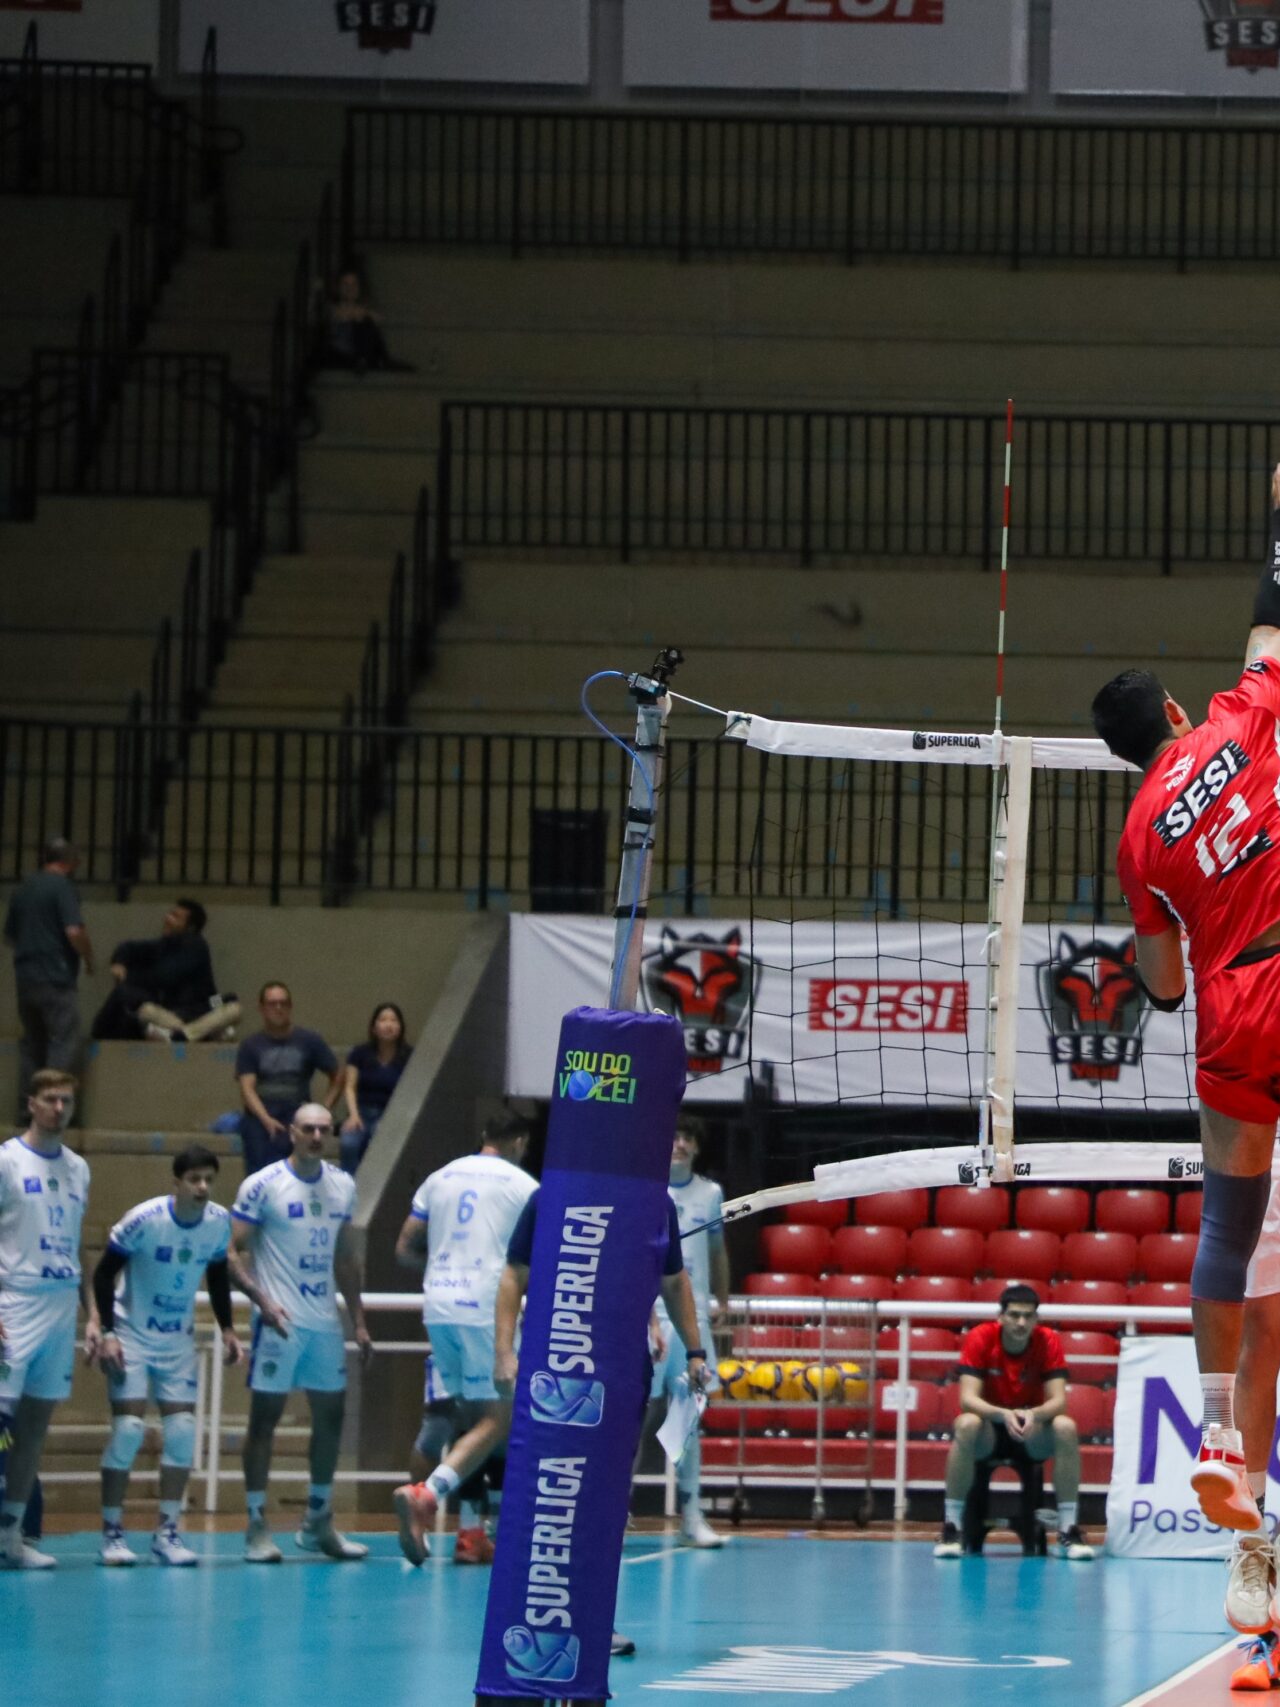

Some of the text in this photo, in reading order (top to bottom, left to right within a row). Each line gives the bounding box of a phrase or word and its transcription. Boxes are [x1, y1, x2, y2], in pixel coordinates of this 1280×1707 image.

[927, 734, 981, 749] SUPERLIGA
[1165, 747, 1239, 837] SESI
[821, 984, 956, 1030] SESI
[684, 1028, 738, 1055] ESI
[1056, 1035, 1137, 1063] SESI
[564, 1050, 632, 1075] SOU DO
[457, 1188, 479, 1224] 6
[308, 1226, 329, 1249] 20
[547, 1205, 615, 1375] SUPERLIGA
[525, 1455, 588, 1629] SUPERLIGA
